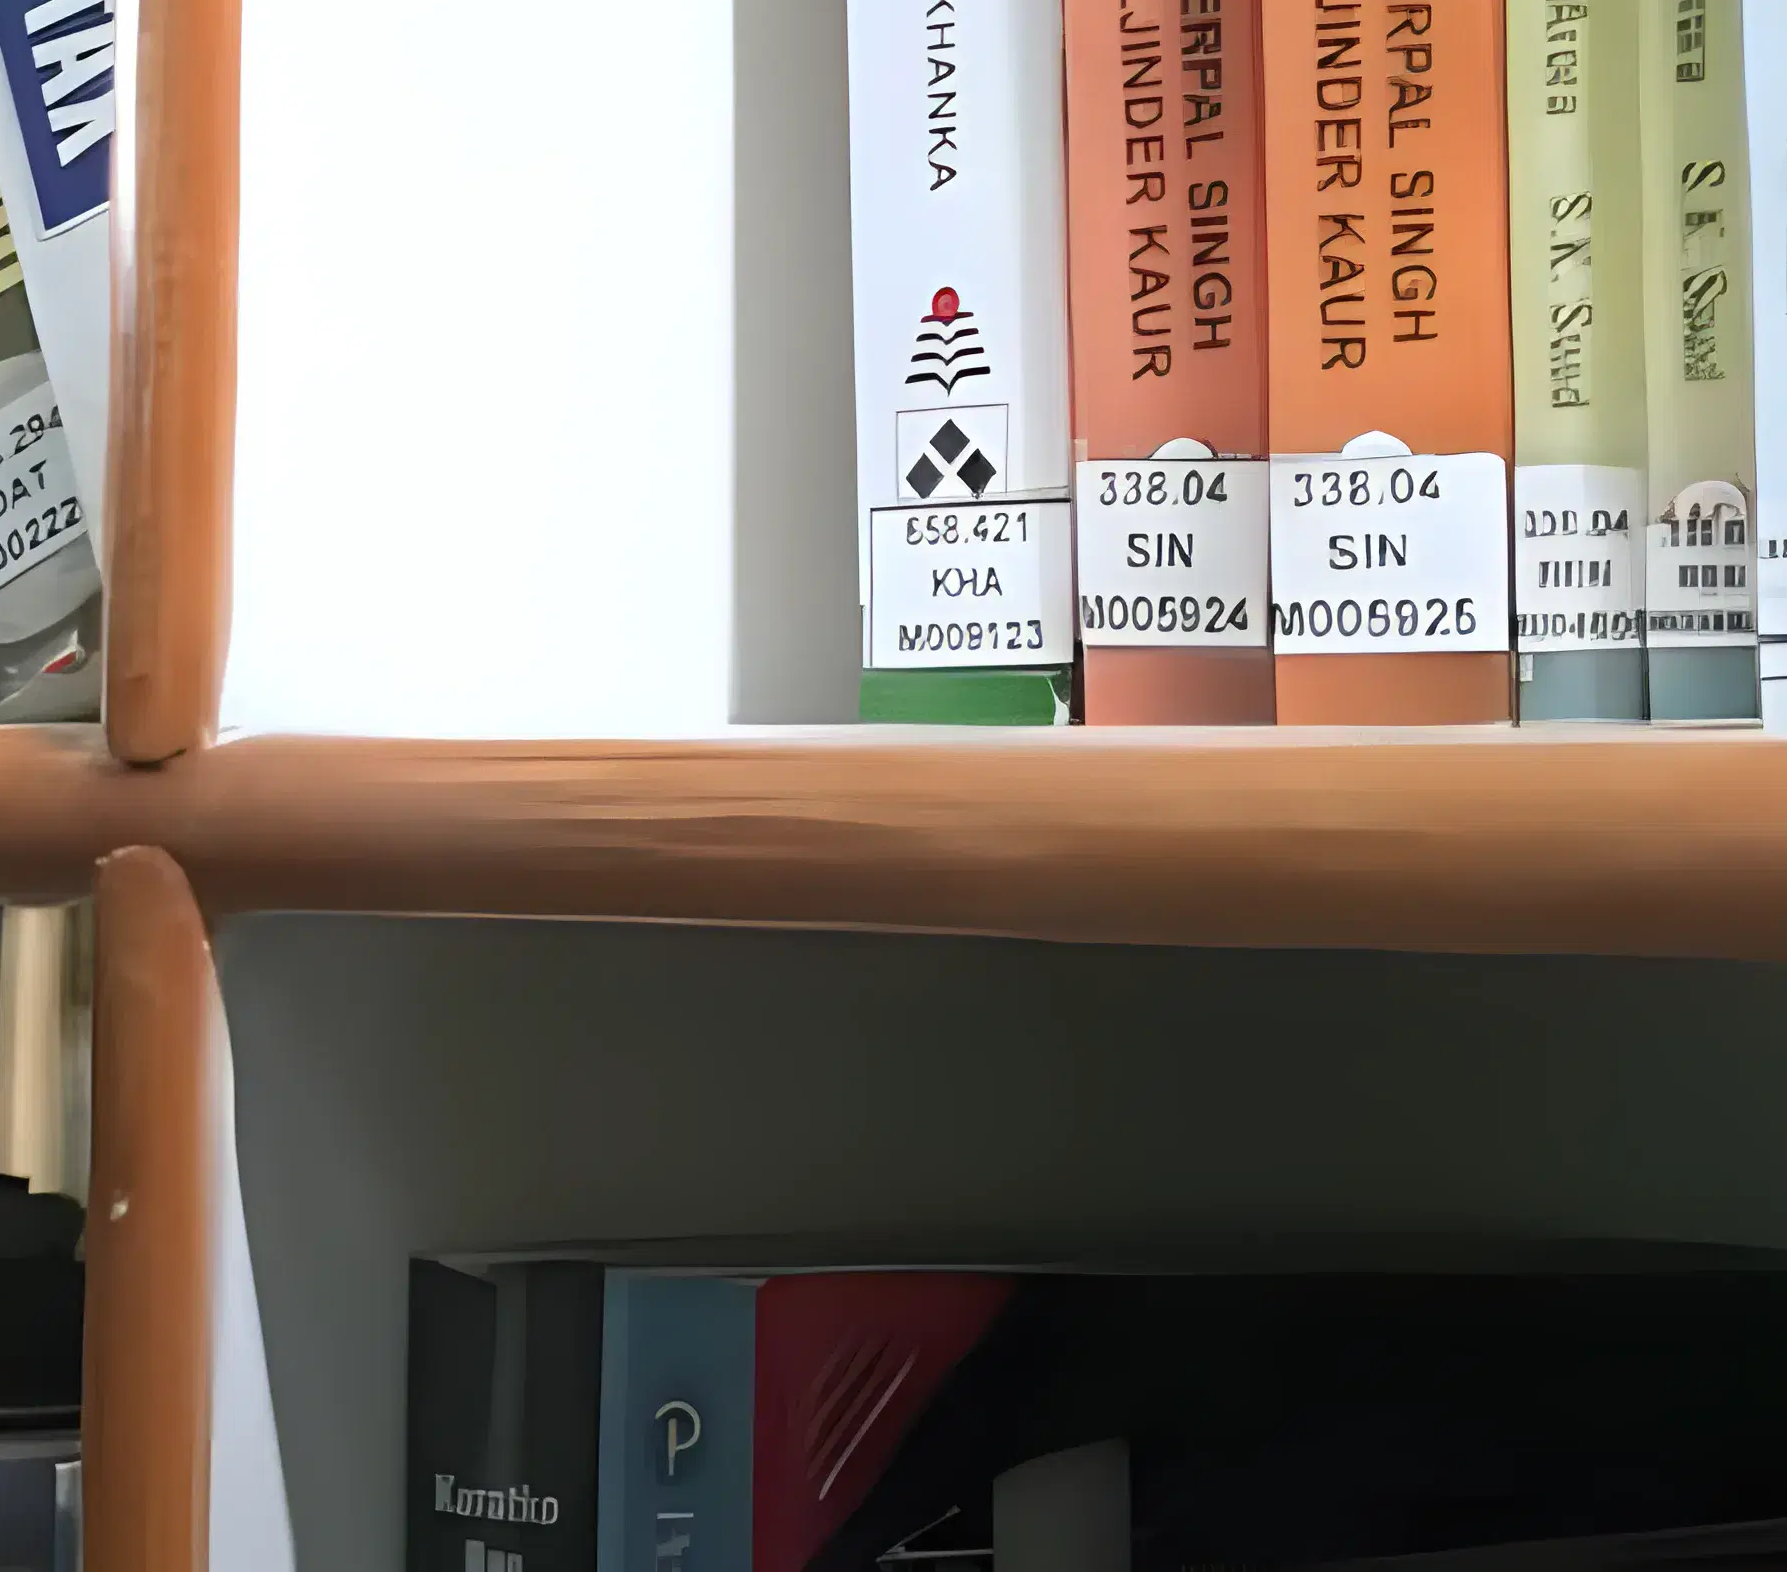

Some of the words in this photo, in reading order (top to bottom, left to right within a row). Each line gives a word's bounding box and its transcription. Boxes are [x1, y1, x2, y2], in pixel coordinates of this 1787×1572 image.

[1186, 181, 1232, 352] SINGH
[1389, 170, 1438, 346] SINGH
[1125, 223, 1174, 383] KAUR
[1318, 211, 1368, 372] KAUR
[1099, 469, 1228, 507] 338.04
[1294, 468, 1440, 508] 338.04
[1126, 533, 1194, 569] SIN
[1327, 533, 1409, 571] SIN
[931, 566, 1004, 598] KHA
